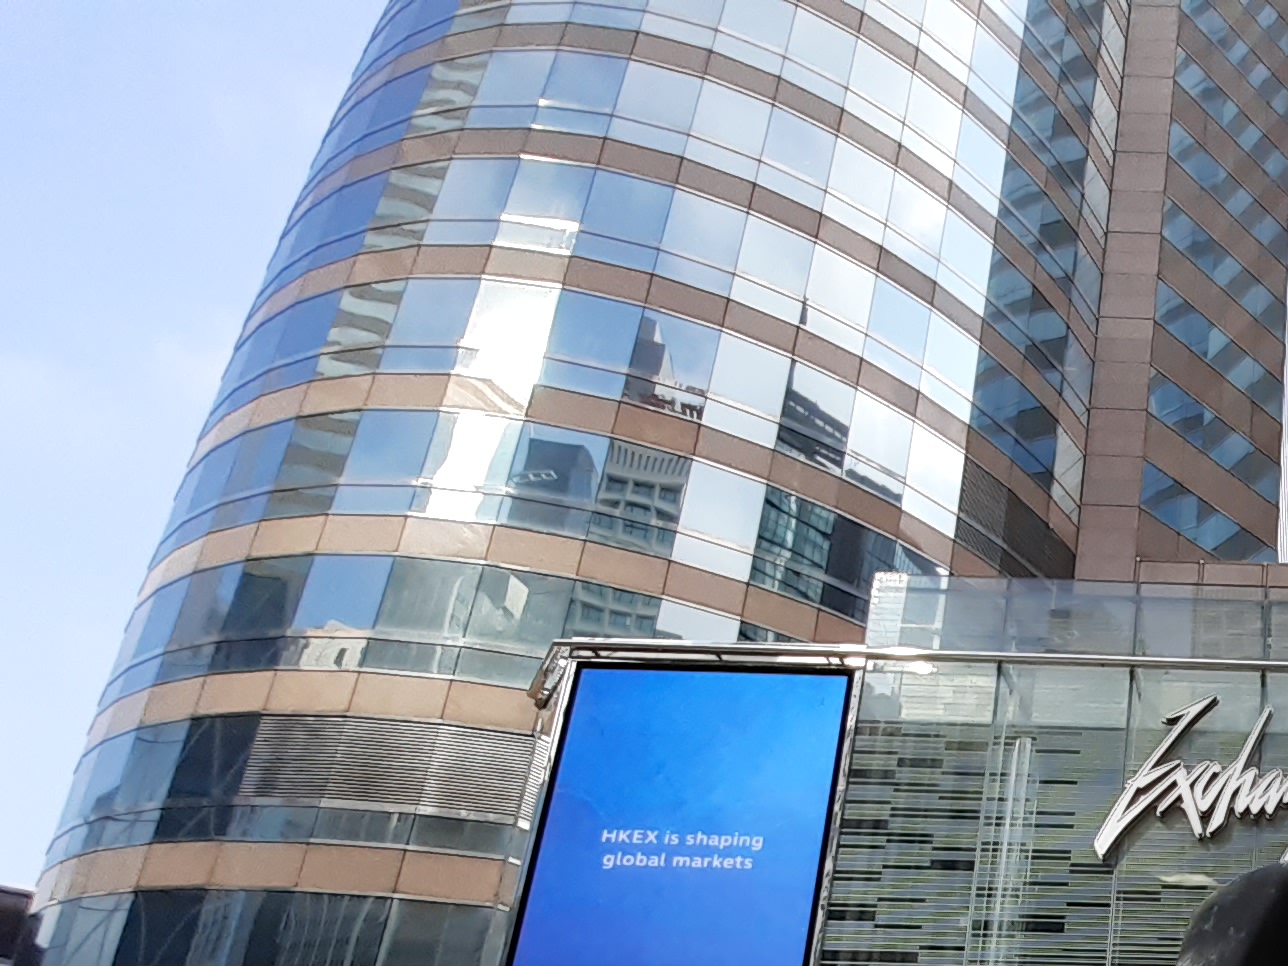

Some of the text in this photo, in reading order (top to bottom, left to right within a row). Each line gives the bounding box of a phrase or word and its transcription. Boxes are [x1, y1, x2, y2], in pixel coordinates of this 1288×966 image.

[601, 829, 764, 851] HKEX is shaping
[602, 852, 753, 869] global markets
